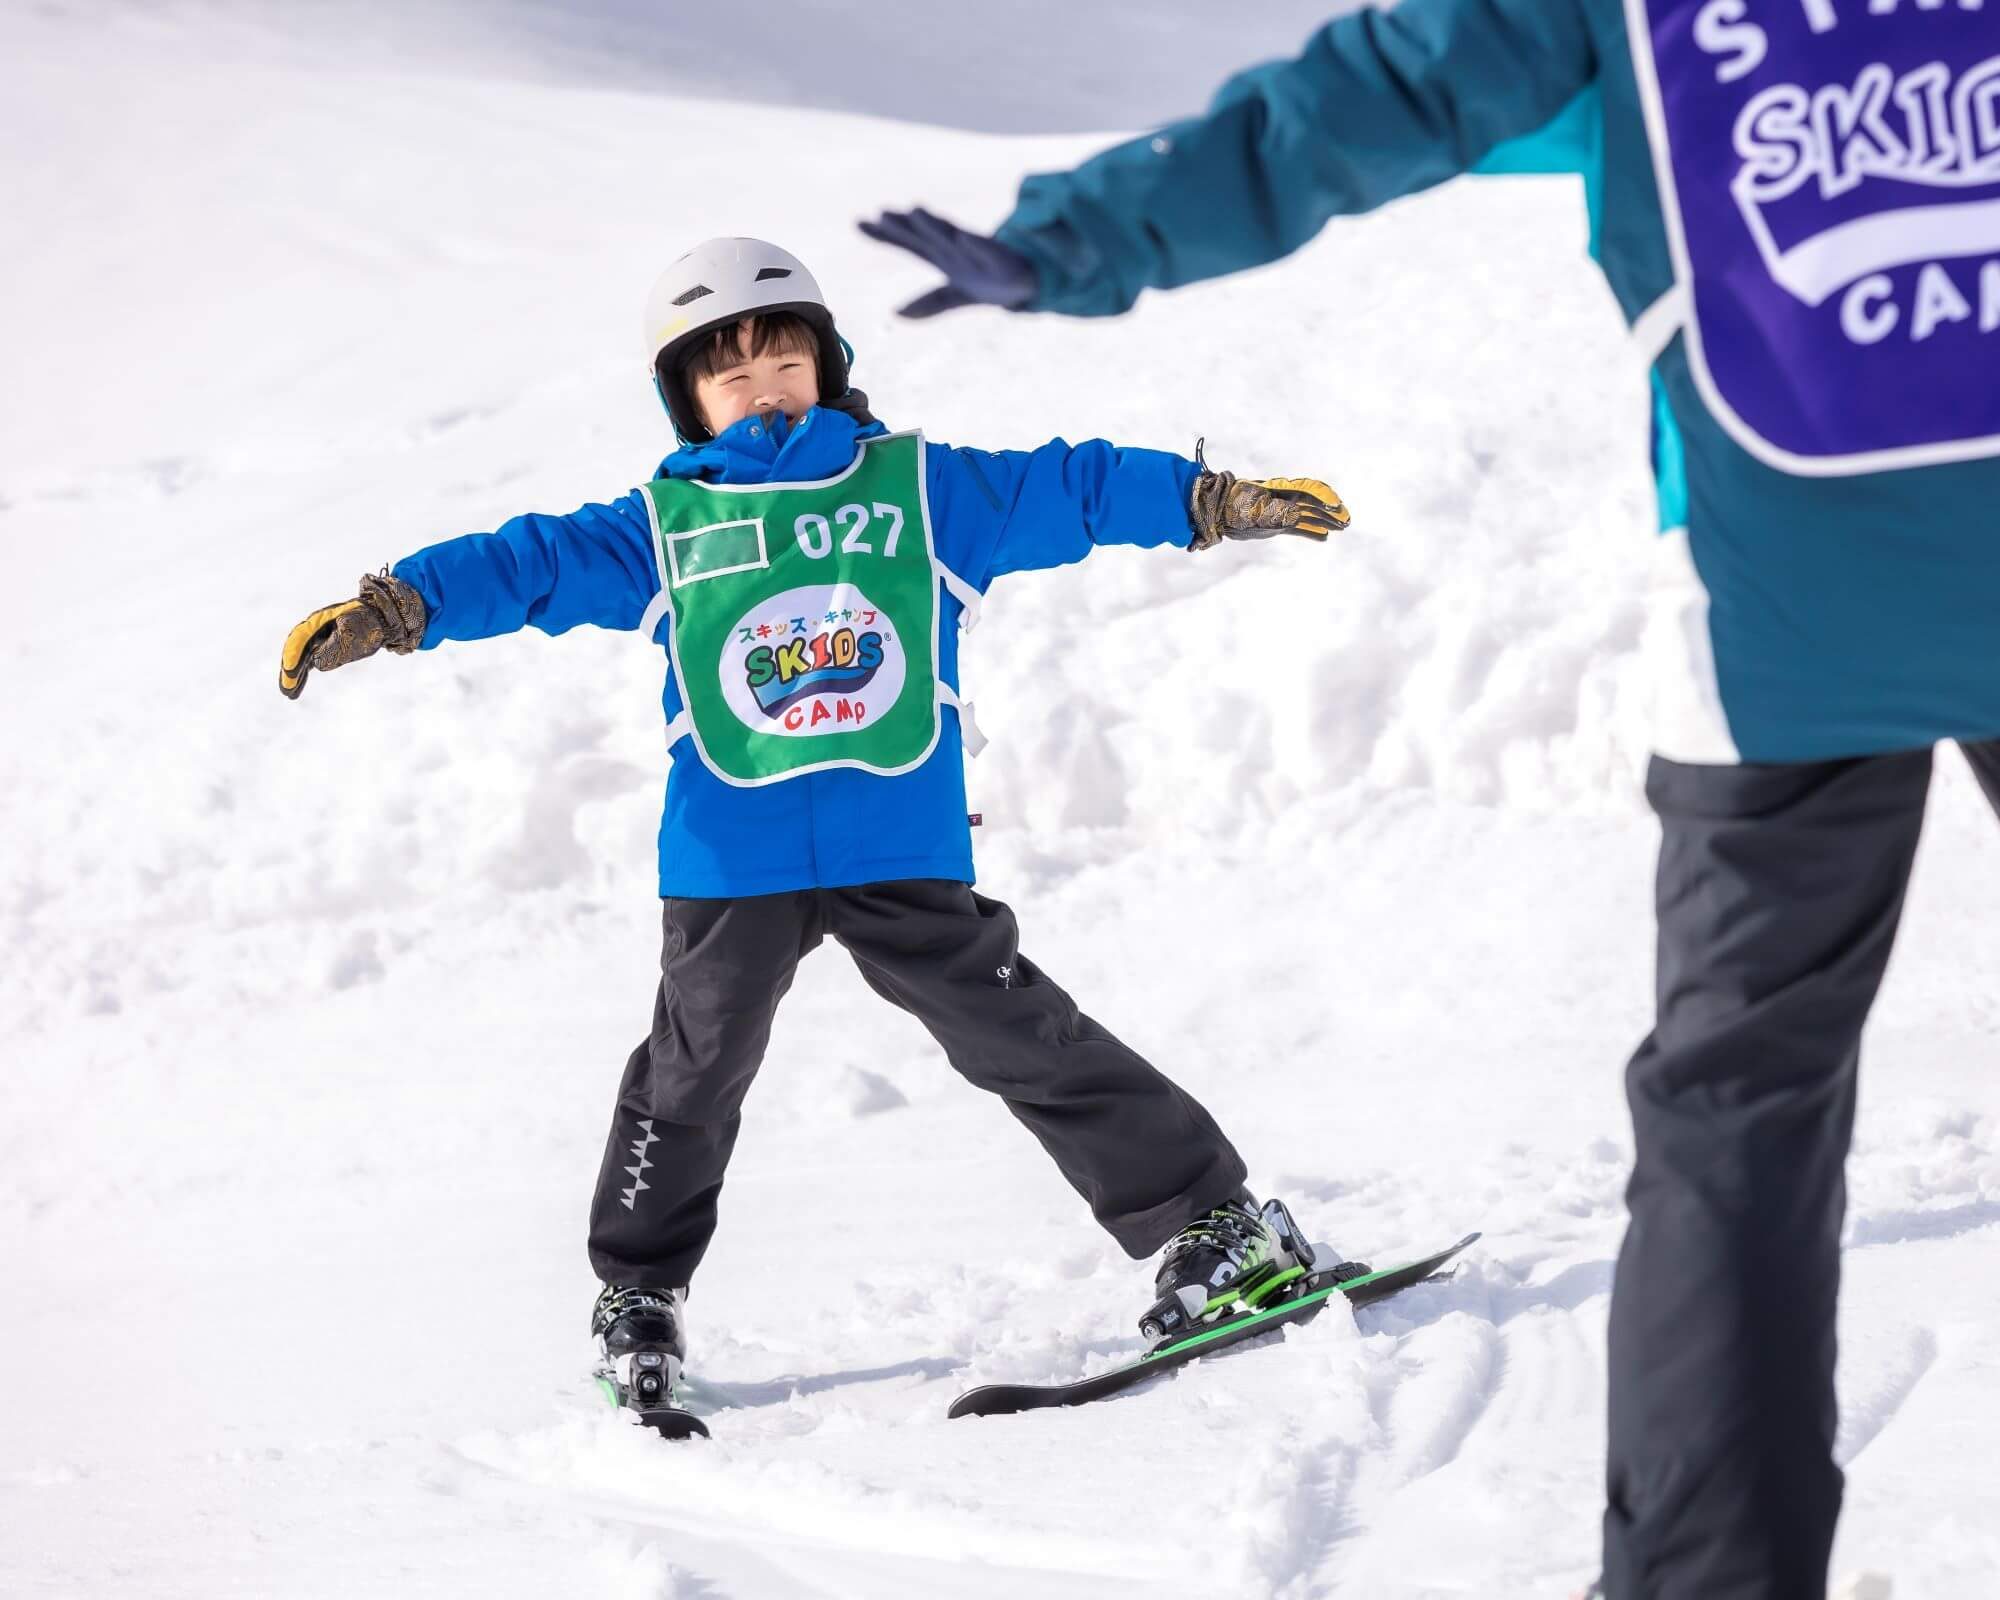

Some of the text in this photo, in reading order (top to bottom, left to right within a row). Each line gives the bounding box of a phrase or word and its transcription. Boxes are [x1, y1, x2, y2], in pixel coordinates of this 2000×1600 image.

[1732, 55, 2000, 200] SKID
[794, 502, 904, 559] 027
[745, 627, 884, 687] SKIDS
